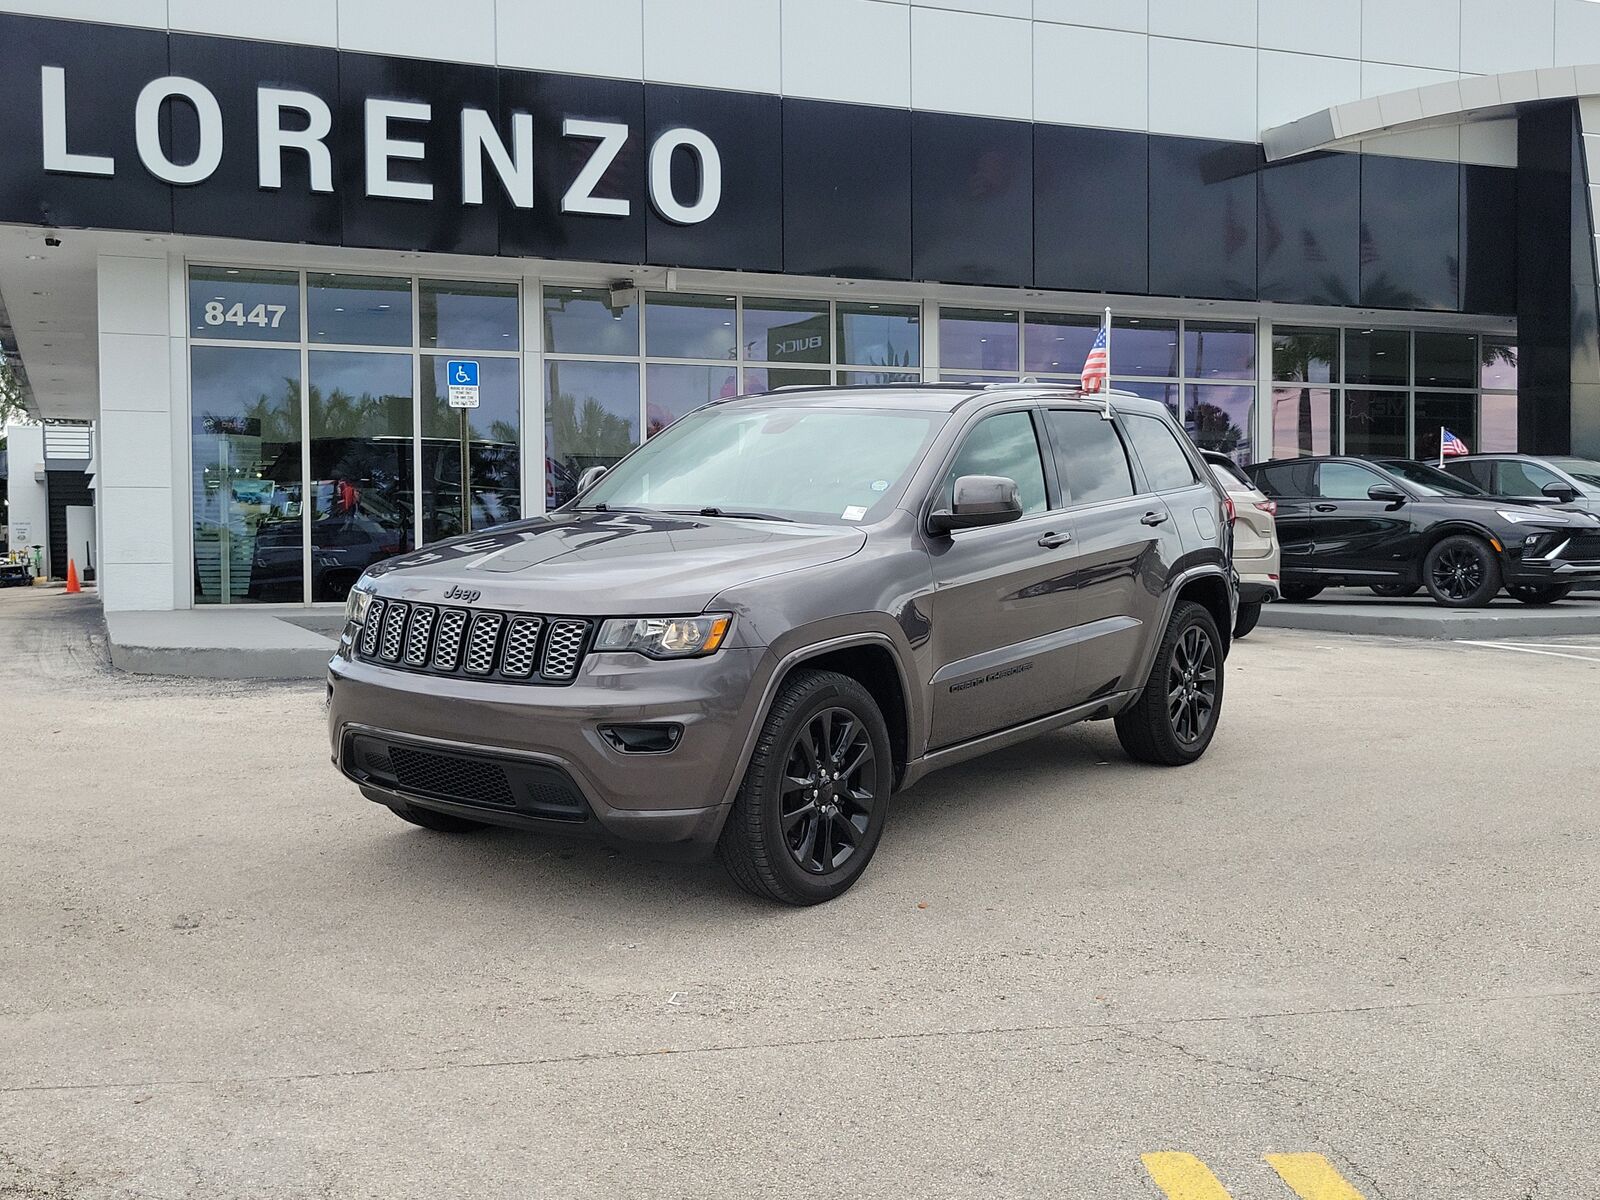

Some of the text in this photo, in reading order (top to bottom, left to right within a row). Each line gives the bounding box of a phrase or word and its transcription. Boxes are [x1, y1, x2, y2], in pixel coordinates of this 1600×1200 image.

[41, 65, 722, 226] LORENZO
[204, 301, 286, 328] 8447
[443, 584, 482, 604] Jeep
